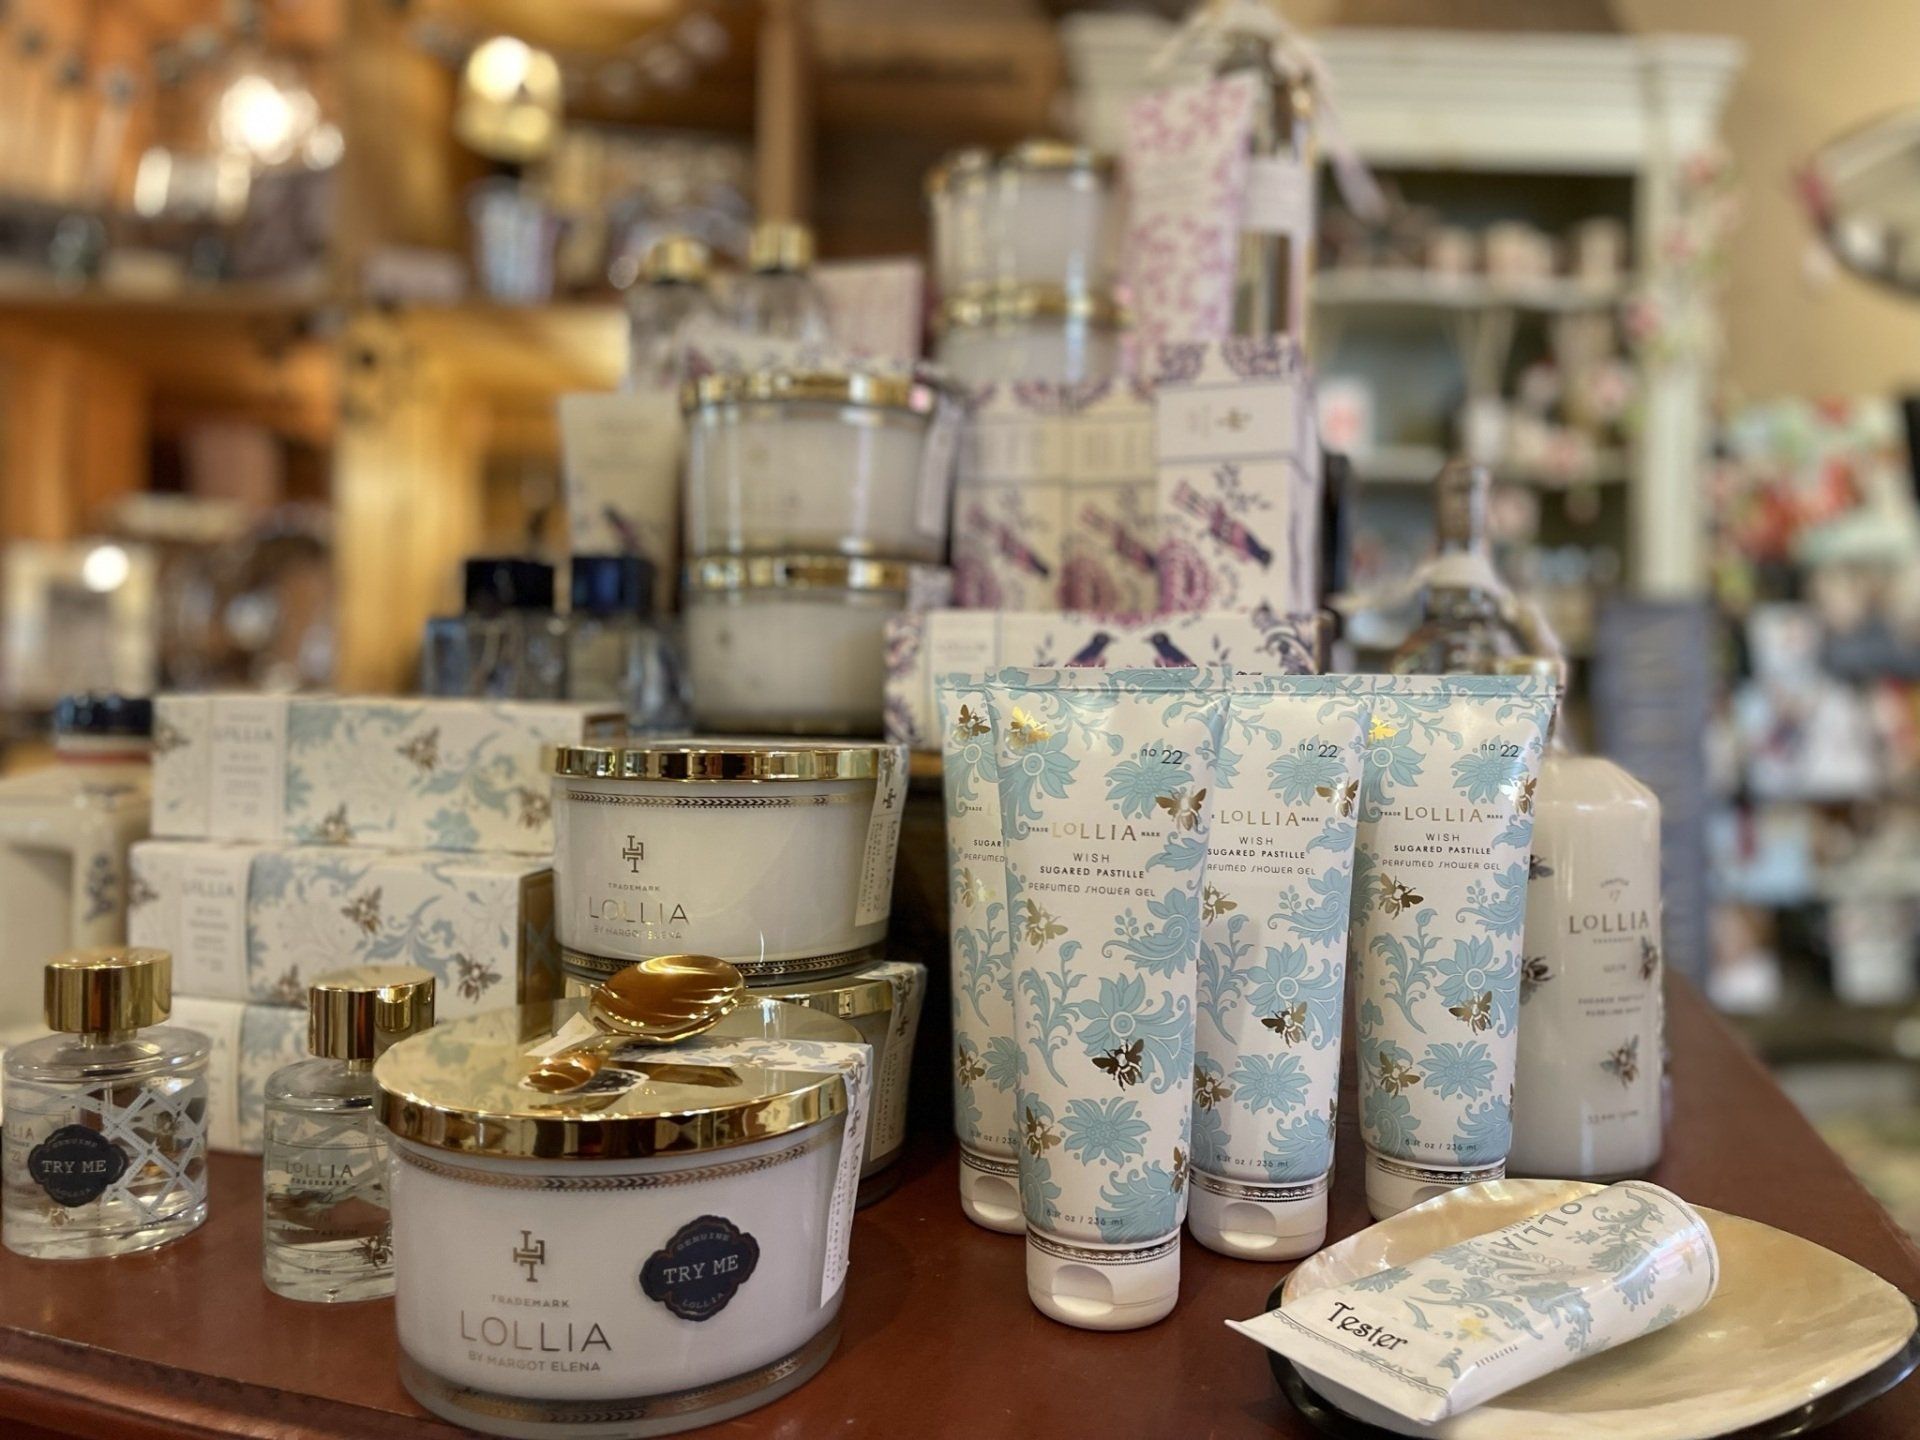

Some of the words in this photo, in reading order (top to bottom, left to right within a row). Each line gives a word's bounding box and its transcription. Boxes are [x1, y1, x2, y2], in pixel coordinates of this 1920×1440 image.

[1161, 749, 1183, 765] 22
[1318, 744, 1338, 758] 22
[1500, 744, 1519, 758] 22
[1221, 810, 1300, 826] LOLLIA
[1404, 807, 1483, 823] LOLLIA
[1052, 822, 1137, 842] LOLLIA
[1426, 832, 1460, 842] WISH
[1239, 836, 1274, 846] WISH
[1207, 848, 1256, 857] SUGARED
[1261, 850, 1306, 859] PASTILLE
[1394, 845, 1443, 853] SUGARED
[1448, 846, 1491, 855] PASTILLE
[964, 853, 1005, 863] PERFUMED
[1073, 853, 1110, 863] WISH
[1382, 859, 1434, 868] PERFUMED
[1438, 861, 1479, 869] SHOWER
[1483, 863, 1501, 871] GEL
[1040, 866, 1091, 876] SUGARED
[1096, 868, 1145, 879] PASTILLE
[1250, 864, 1293, 874] SHOWER
[1297, 867, 1316, 876] GEL
[608, 882, 660, 892] TRADEMARK
[1028, 882, 1081, 894] PERFUMED
[1085, 886, 1130, 896] SHOWER
[1135, 888, 1156, 898] GEL
[589, 896, 690, 926] LOLLIA
[1569, 910, 1650, 935] LOLLIA
[605, 927, 642, 938] MARGO
[1446, 1143, 1463, 1151] 236
[42, 1160, 75, 1174] TRY
[82, 1160, 107, 1174] ME
[286, 1161, 354, 1178] LOLLIA
[1256, 1160, 1274, 1168] 236
[1064, 1214, 1075, 1222] oz
[1087, 1216, 1106, 1226] 236
[663, 1262, 706, 1285] TRY
[713, 1254, 739, 1276] ME
[491, 1294, 570, 1308] TRADEMARK
[460, 1309, 612, 1353] LOLLIA
[1327, 1301, 1408, 1350] Tester
[468, 1350, 483, 1362] BY
[487, 1355, 546, 1371] MARGOT
[550, 1360, 601, 1373] ELENA
